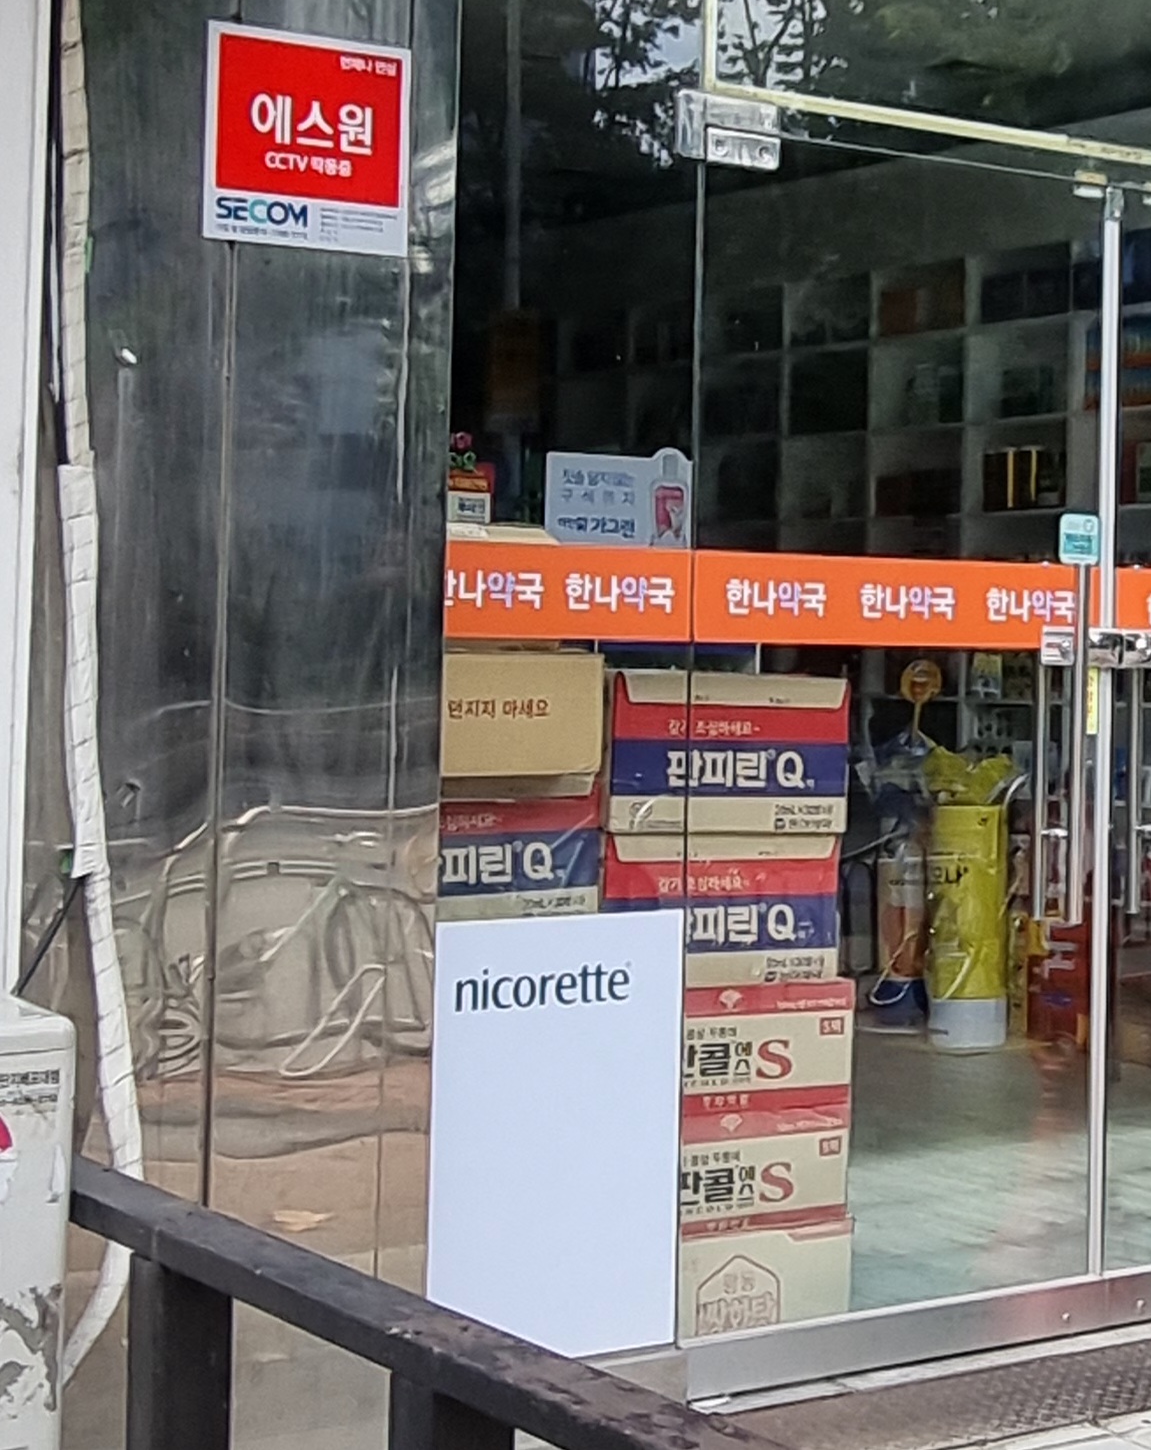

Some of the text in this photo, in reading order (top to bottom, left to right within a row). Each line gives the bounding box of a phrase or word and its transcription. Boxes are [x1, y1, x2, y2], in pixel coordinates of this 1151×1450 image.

[251, 93, 373, 156] 에스원
[265, 151, 308, 172] CCTV
[216, 196, 308, 229] SECOM
[566, 572, 675, 613] 한나약국
[726, 578, 827, 618] 한나약국
[860, 583, 956, 620] 한나약국
[986, 587, 1075, 623] 한나약국
[503, 699, 550, 719] 마세요
[439, 842, 555, 885] 피린Q
[454, 962, 631, 1013] nicorette
[756, 1039, 793, 1080] S
[758, 1161, 794, 1203] S
